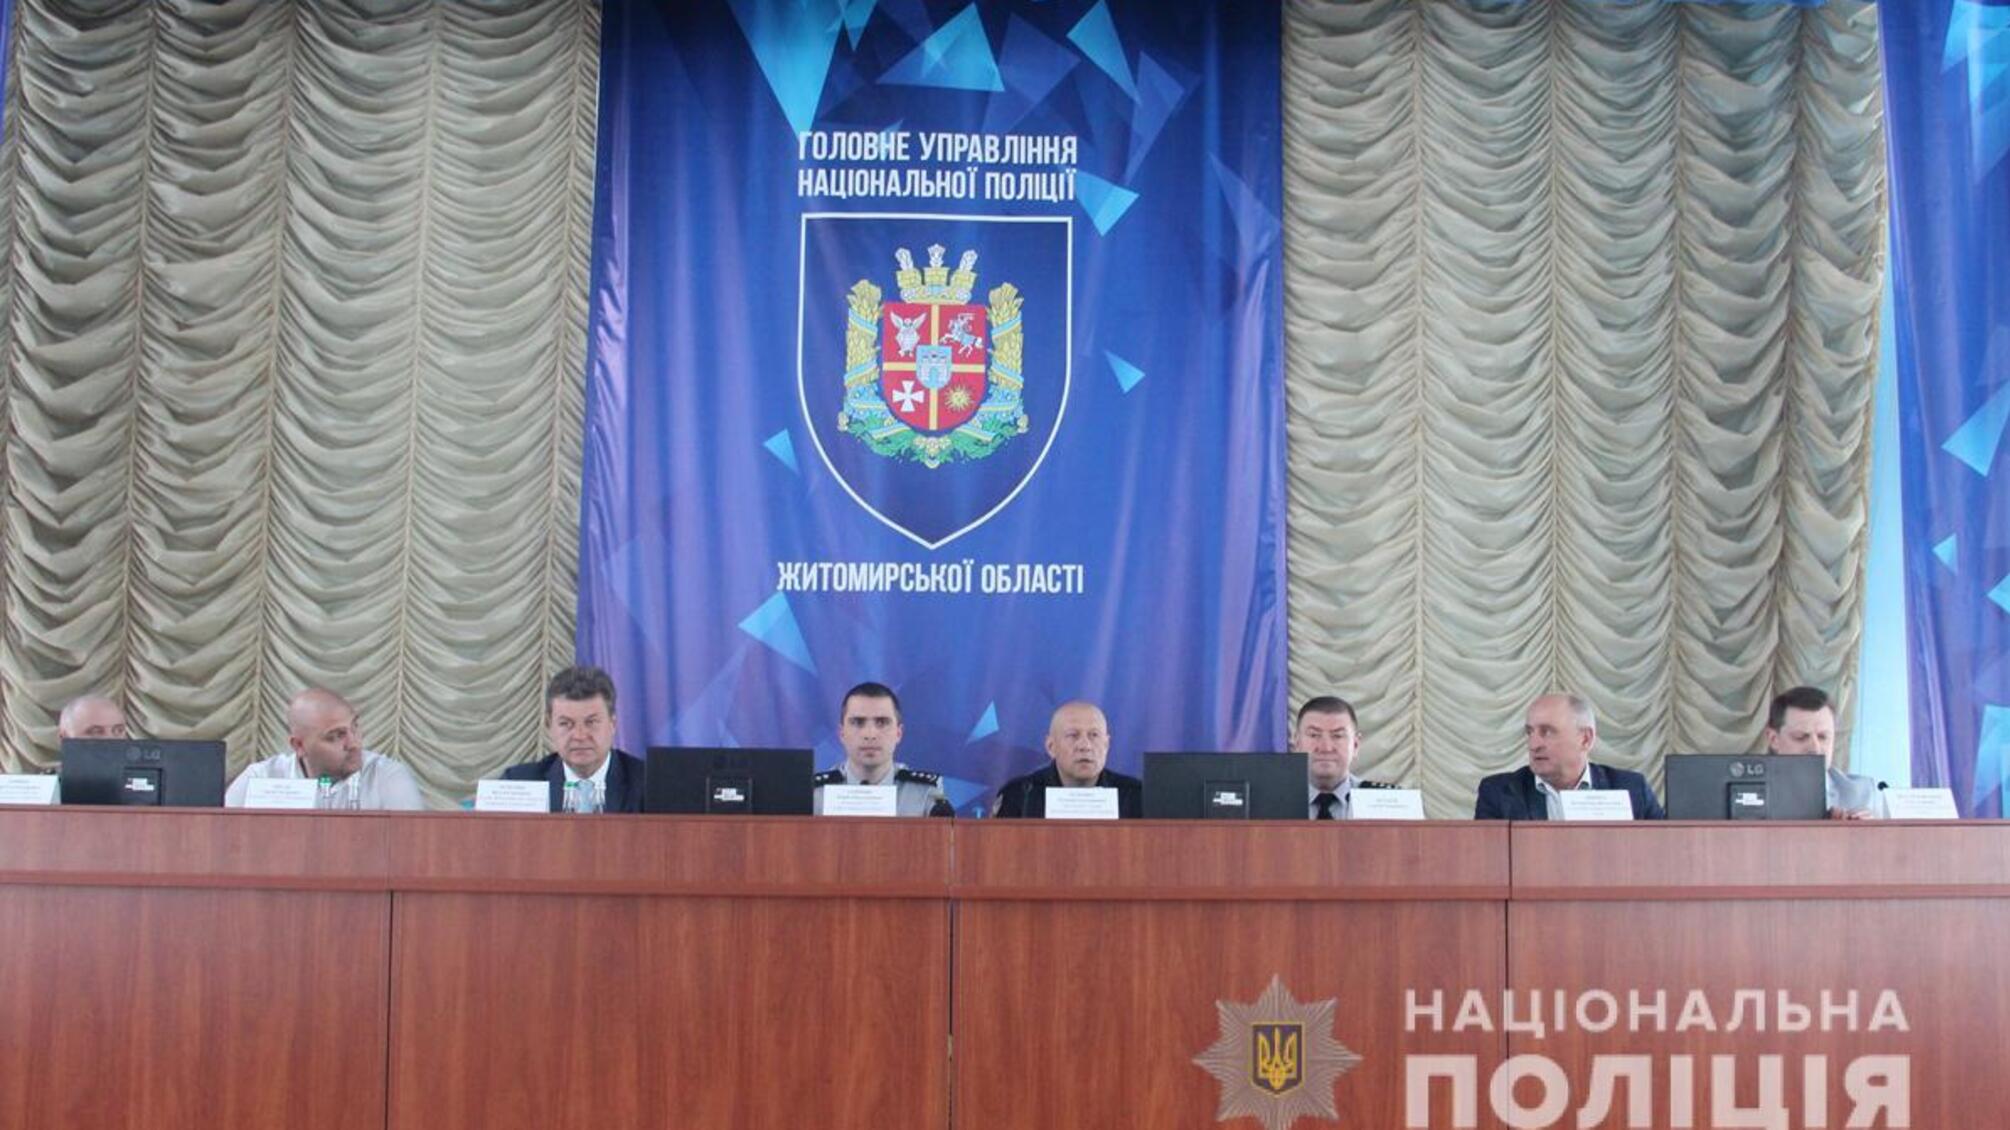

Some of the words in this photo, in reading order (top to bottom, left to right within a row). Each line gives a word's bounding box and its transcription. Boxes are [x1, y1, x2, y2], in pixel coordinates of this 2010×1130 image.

[798, 131, 910, 161] ГОЛОВНЕ
[920, 133, 1078, 165] УПРАВЛІННЯ
[797, 167, 977, 199] НАЦІОНАЛЬНОЇ
[985, 169, 1076, 203] ПОЛІЦІЇ
[777, 559, 973, 593] ЖИТОМИРСЬКОЇ
[981, 563, 1084, 594] ОБЛАСТІ
[1746, 764, 1764, 775] LG
